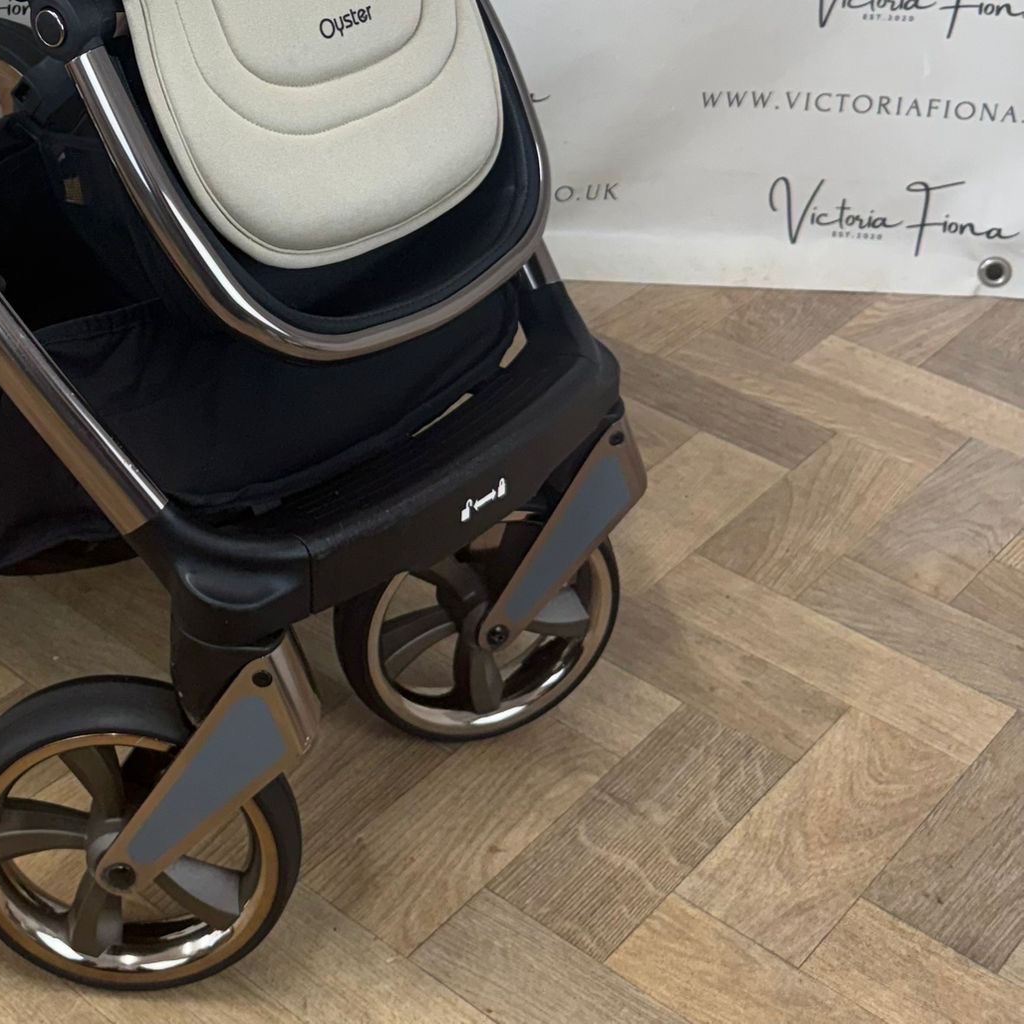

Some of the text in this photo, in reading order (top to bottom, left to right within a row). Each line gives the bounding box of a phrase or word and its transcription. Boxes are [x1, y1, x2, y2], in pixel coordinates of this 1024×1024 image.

[319, 5, 372, 39] Oyster
[769, 177, 1021, 257] Victoria Fiona
